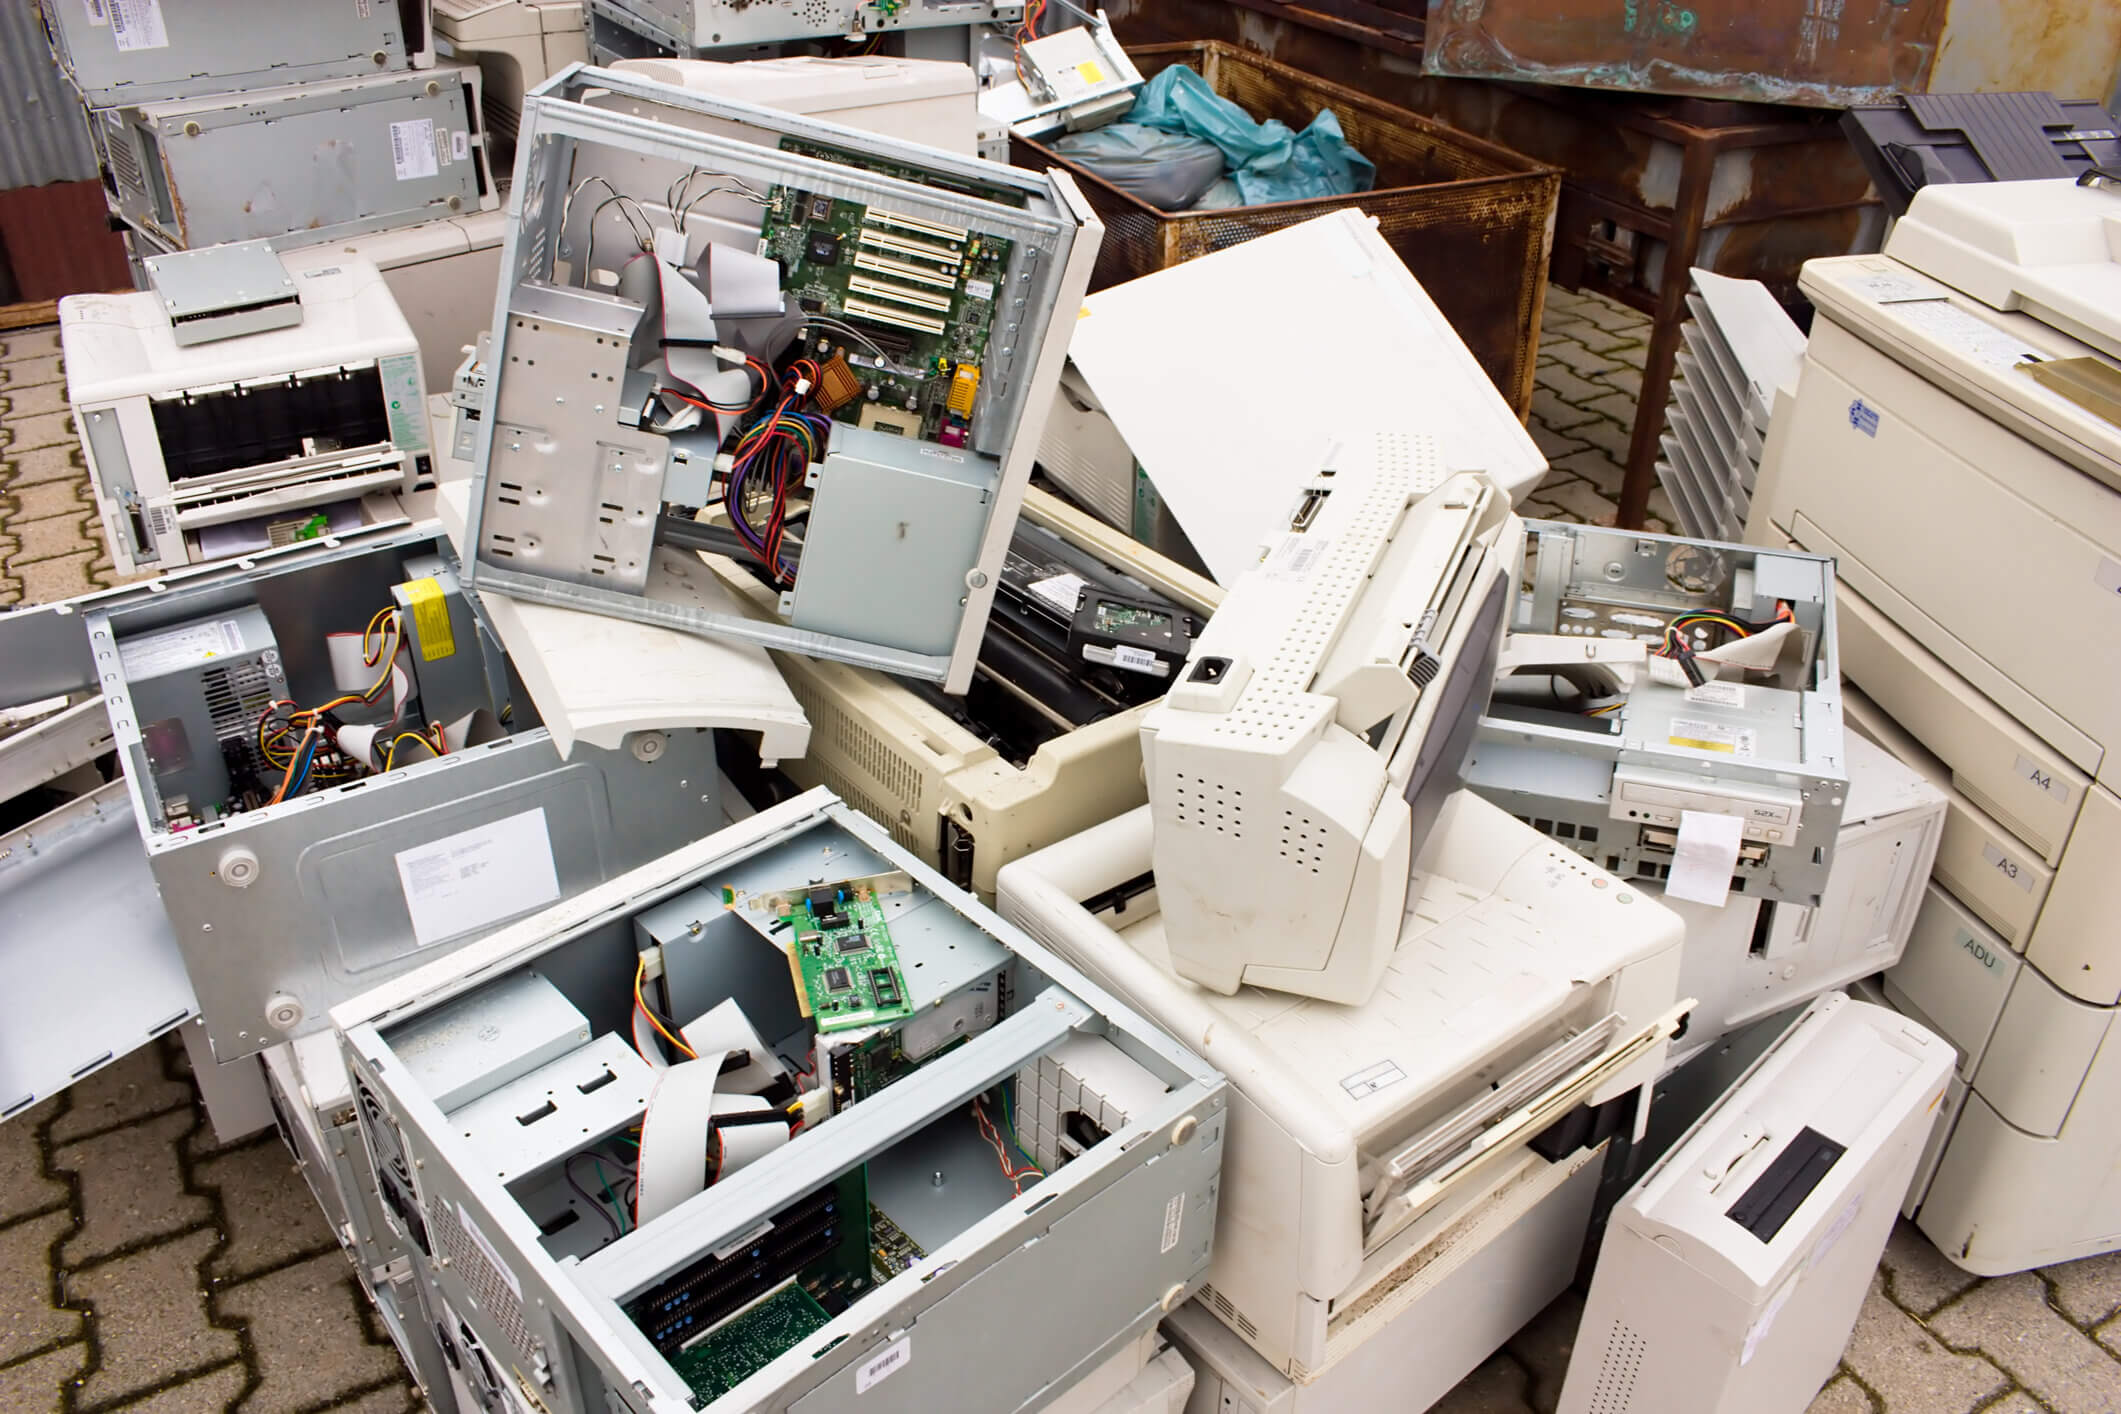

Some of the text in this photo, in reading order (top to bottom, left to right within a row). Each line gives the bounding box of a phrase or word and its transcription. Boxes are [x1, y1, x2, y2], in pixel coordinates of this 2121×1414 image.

[2030, 769, 2051, 790] A4
[1997, 858, 2018, 878] A3
[1964, 939, 1995, 968] ADU
